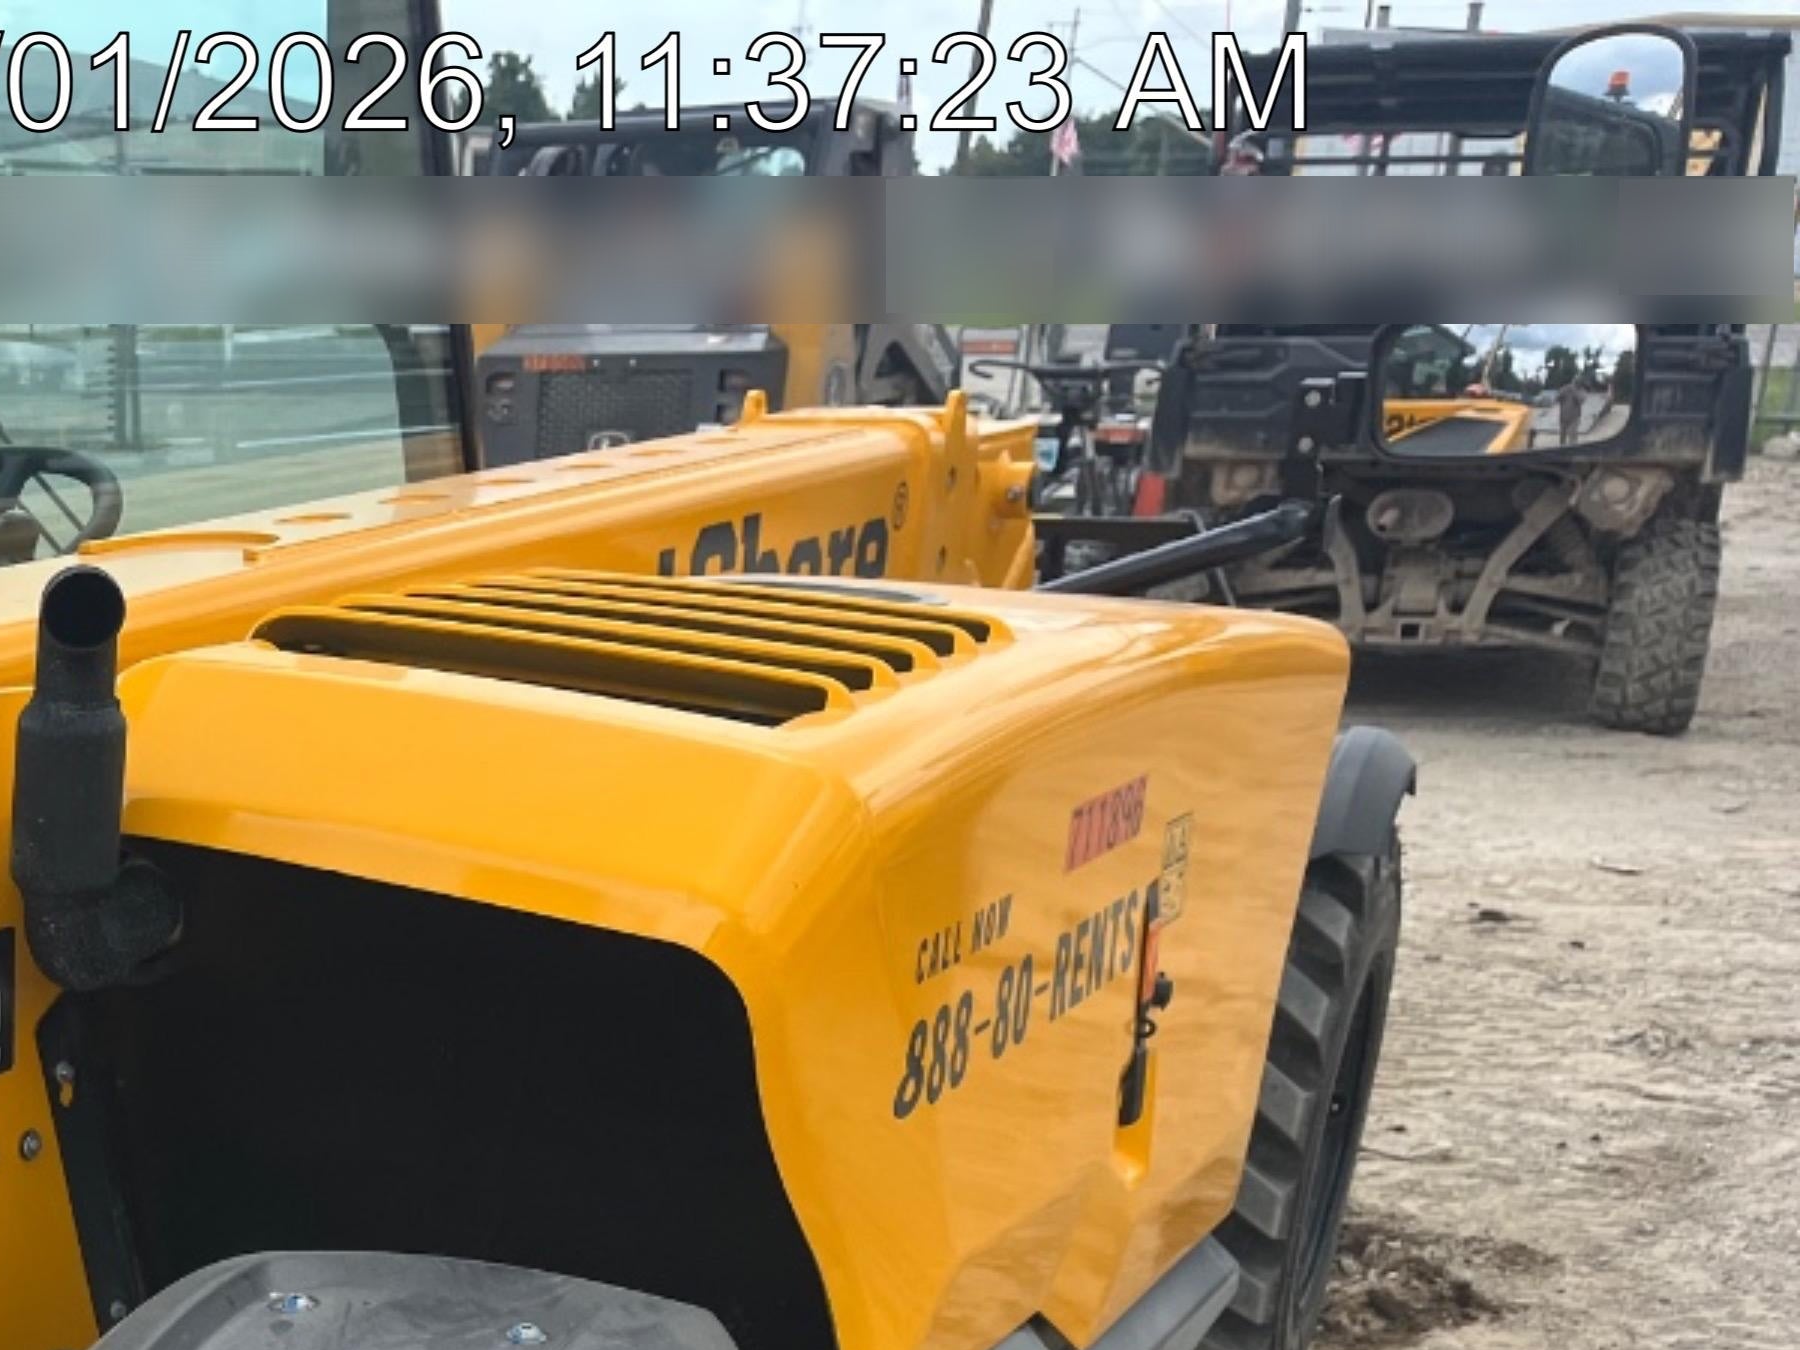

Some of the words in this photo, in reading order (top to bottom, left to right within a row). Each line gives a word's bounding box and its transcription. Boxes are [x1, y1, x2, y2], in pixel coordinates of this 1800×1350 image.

[894, 888, 1139, 1120] 888-80-RENTS
[915, 920, 961, 985] CALL
[971, 893, 1013, 953] NOW
